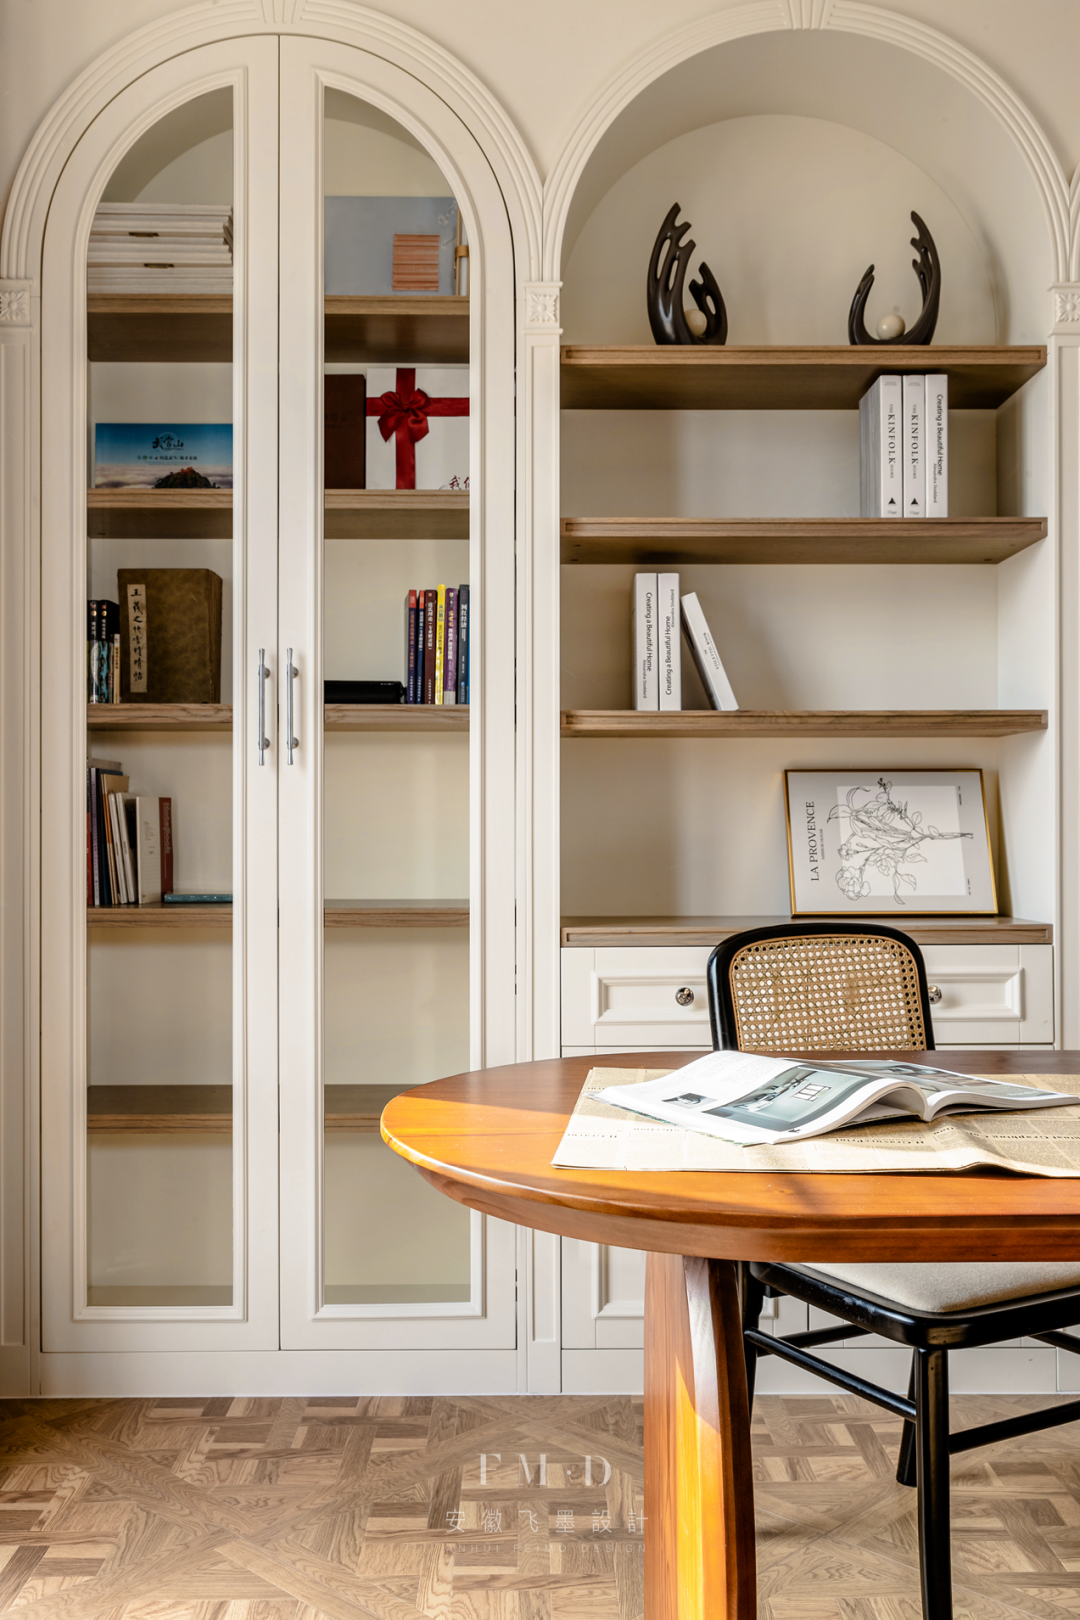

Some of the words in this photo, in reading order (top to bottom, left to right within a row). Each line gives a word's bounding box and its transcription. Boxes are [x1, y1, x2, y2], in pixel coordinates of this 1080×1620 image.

[888, 414, 896, 464] KINFOLK
[910, 414, 919, 464] KINFOLK
[645, 592, 653, 619] Creating
[645, 624, 653, 652] Beautiful
[664, 635, 672, 664] Beautiful
[665, 668, 673, 696] Creating
[805, 801, 818, 862] PROVENCE
[810, 867, 820, 881] LA
